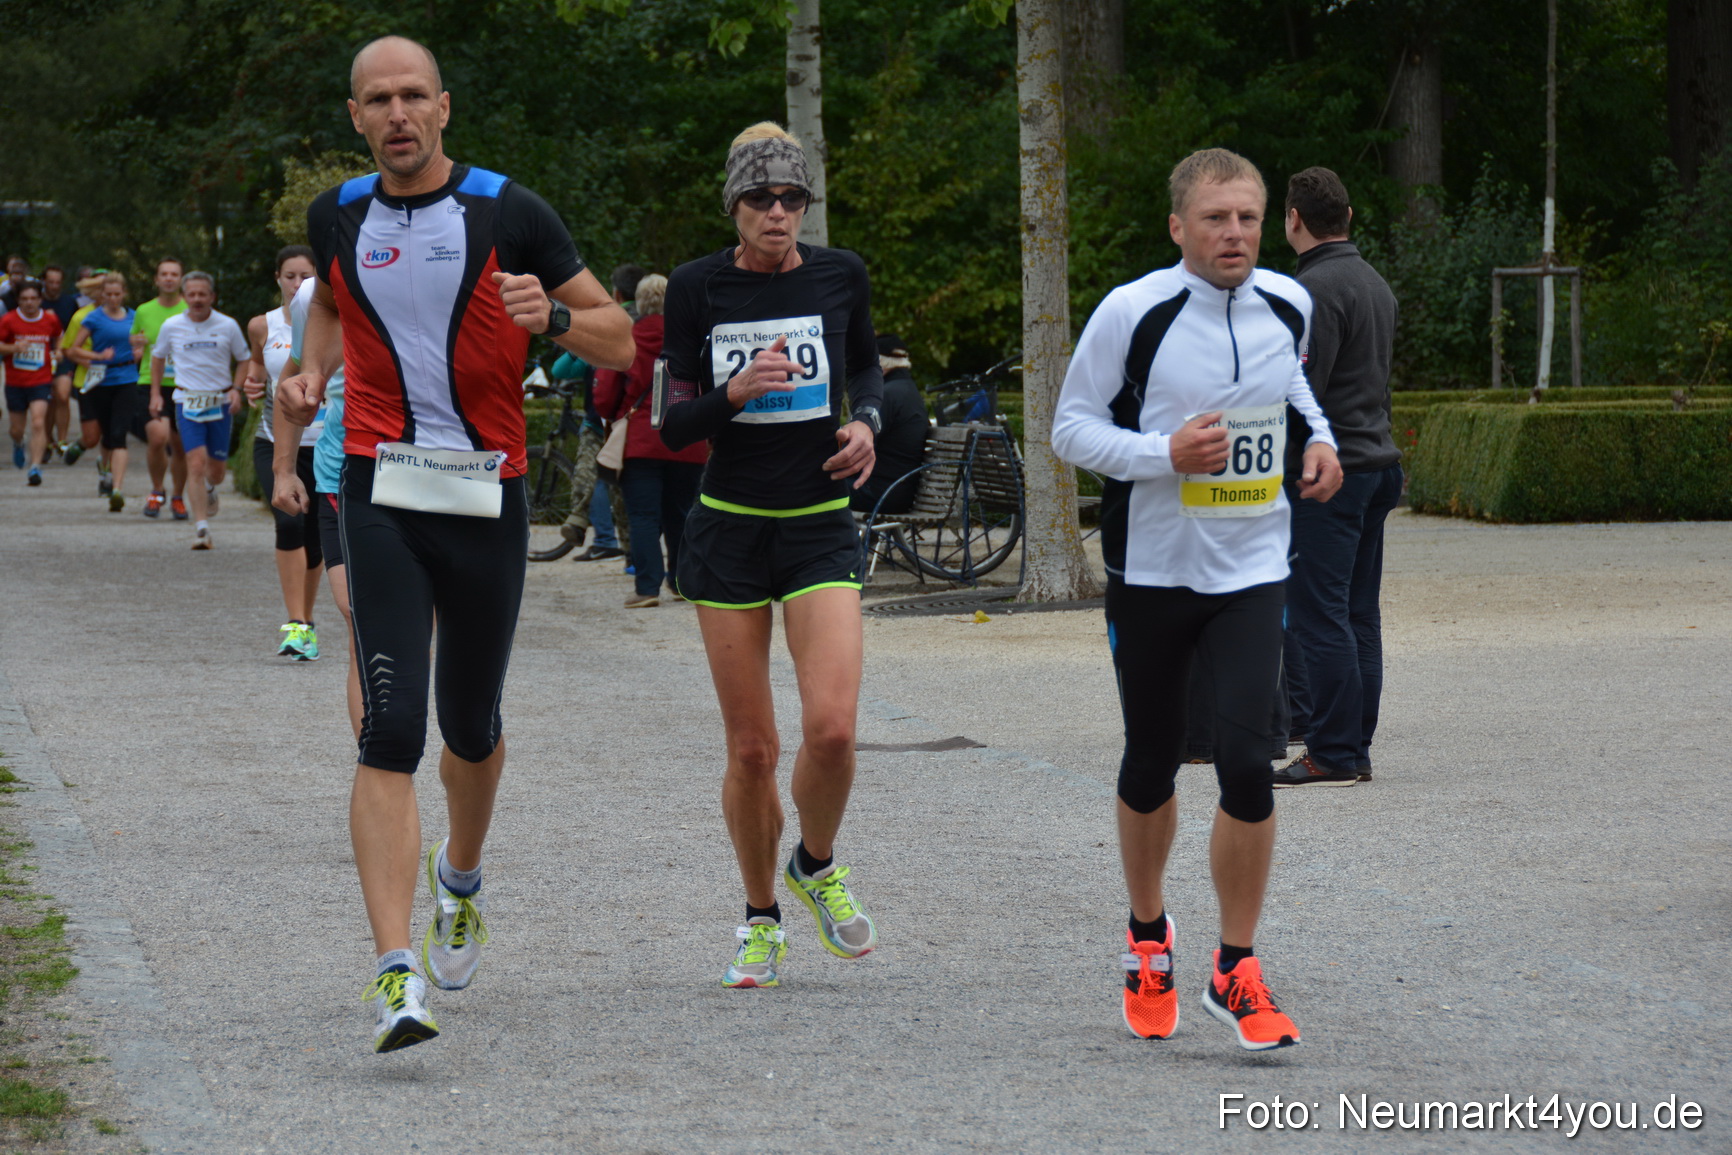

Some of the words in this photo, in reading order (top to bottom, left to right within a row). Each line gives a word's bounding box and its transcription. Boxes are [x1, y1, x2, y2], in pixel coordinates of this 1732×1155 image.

[365, 250, 390, 261] tkn
[715, 333, 751, 344] PARTL
[754, 394, 793, 410] Sissy
[1227, 416, 1276, 430] Neumarkt
[380, 451, 421, 467] PARTL
[423, 458, 480, 472] Neumarkt
[1209, 433, 1274, 477] 68
[1210, 487, 1267, 503] Thomas
